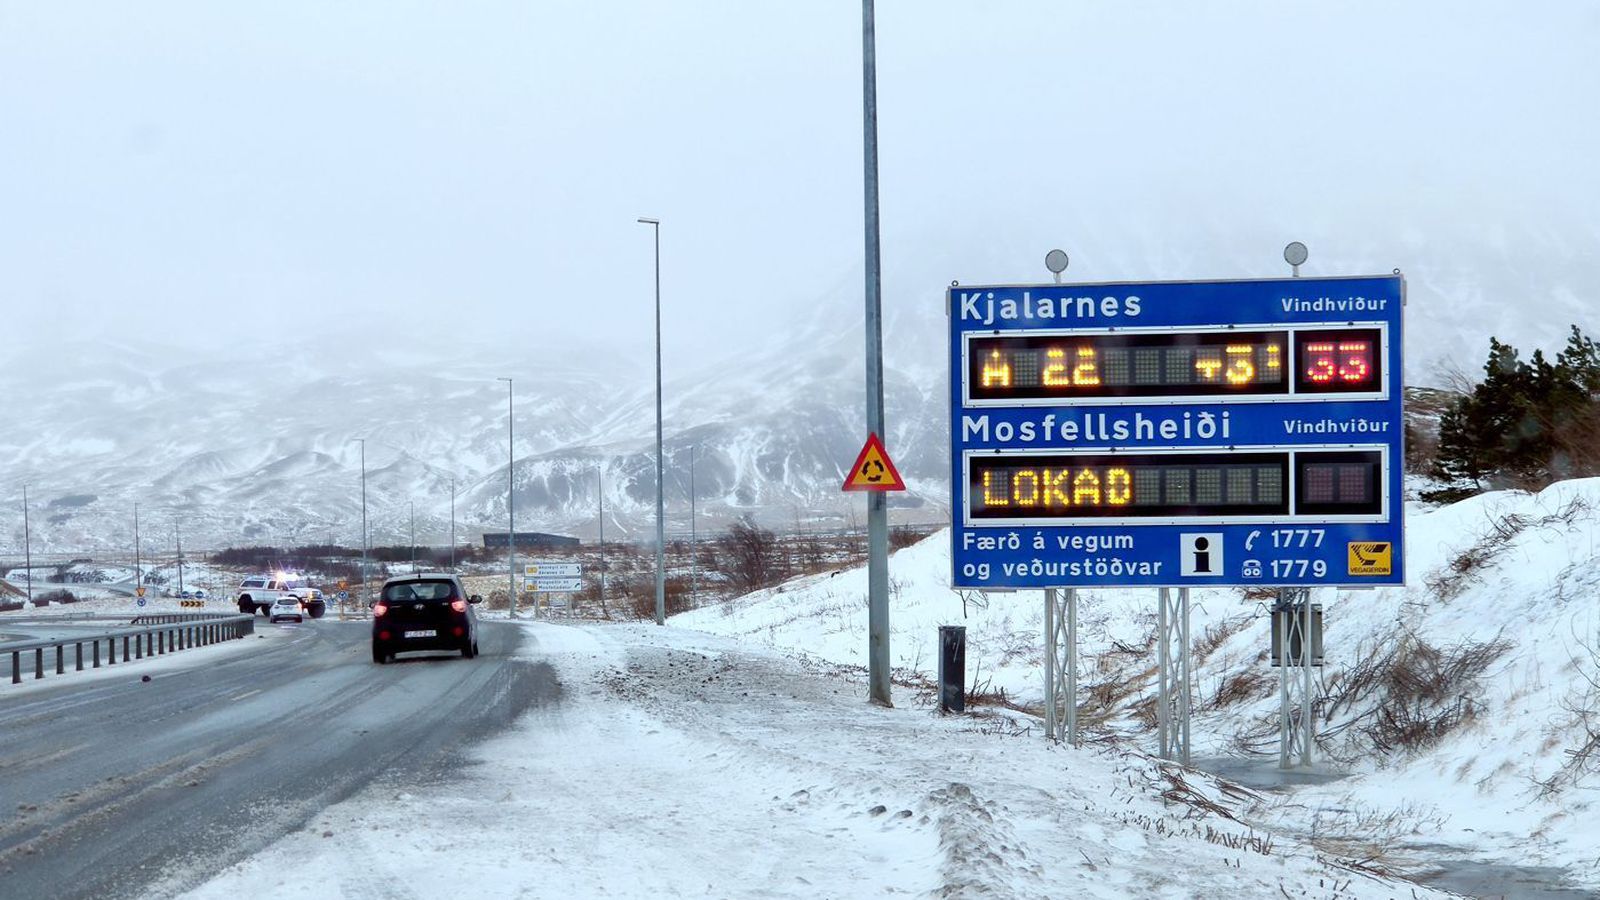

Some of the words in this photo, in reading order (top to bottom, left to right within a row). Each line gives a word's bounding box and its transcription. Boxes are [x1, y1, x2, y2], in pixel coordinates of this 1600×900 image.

[961, 293, 1142, 324] Kjalarnes
[1281, 296, 1387, 312] Vindhviður
[1043, 348, 1100, 387] 22
[962, 411, 1230, 443] Mosfellsheiði
[1283, 418, 1389, 434] Vindhviður
[963, 531, 1020, 550] Færð
[1033, 531, 1045, 550] á
[1057, 535, 1133, 552] vegum
[1270, 530, 1325, 547] 1777
[963, 563, 990, 580] og
[1002, 557, 1162, 578] veðurstöðvar
[1270, 560, 1326, 577] 1779
